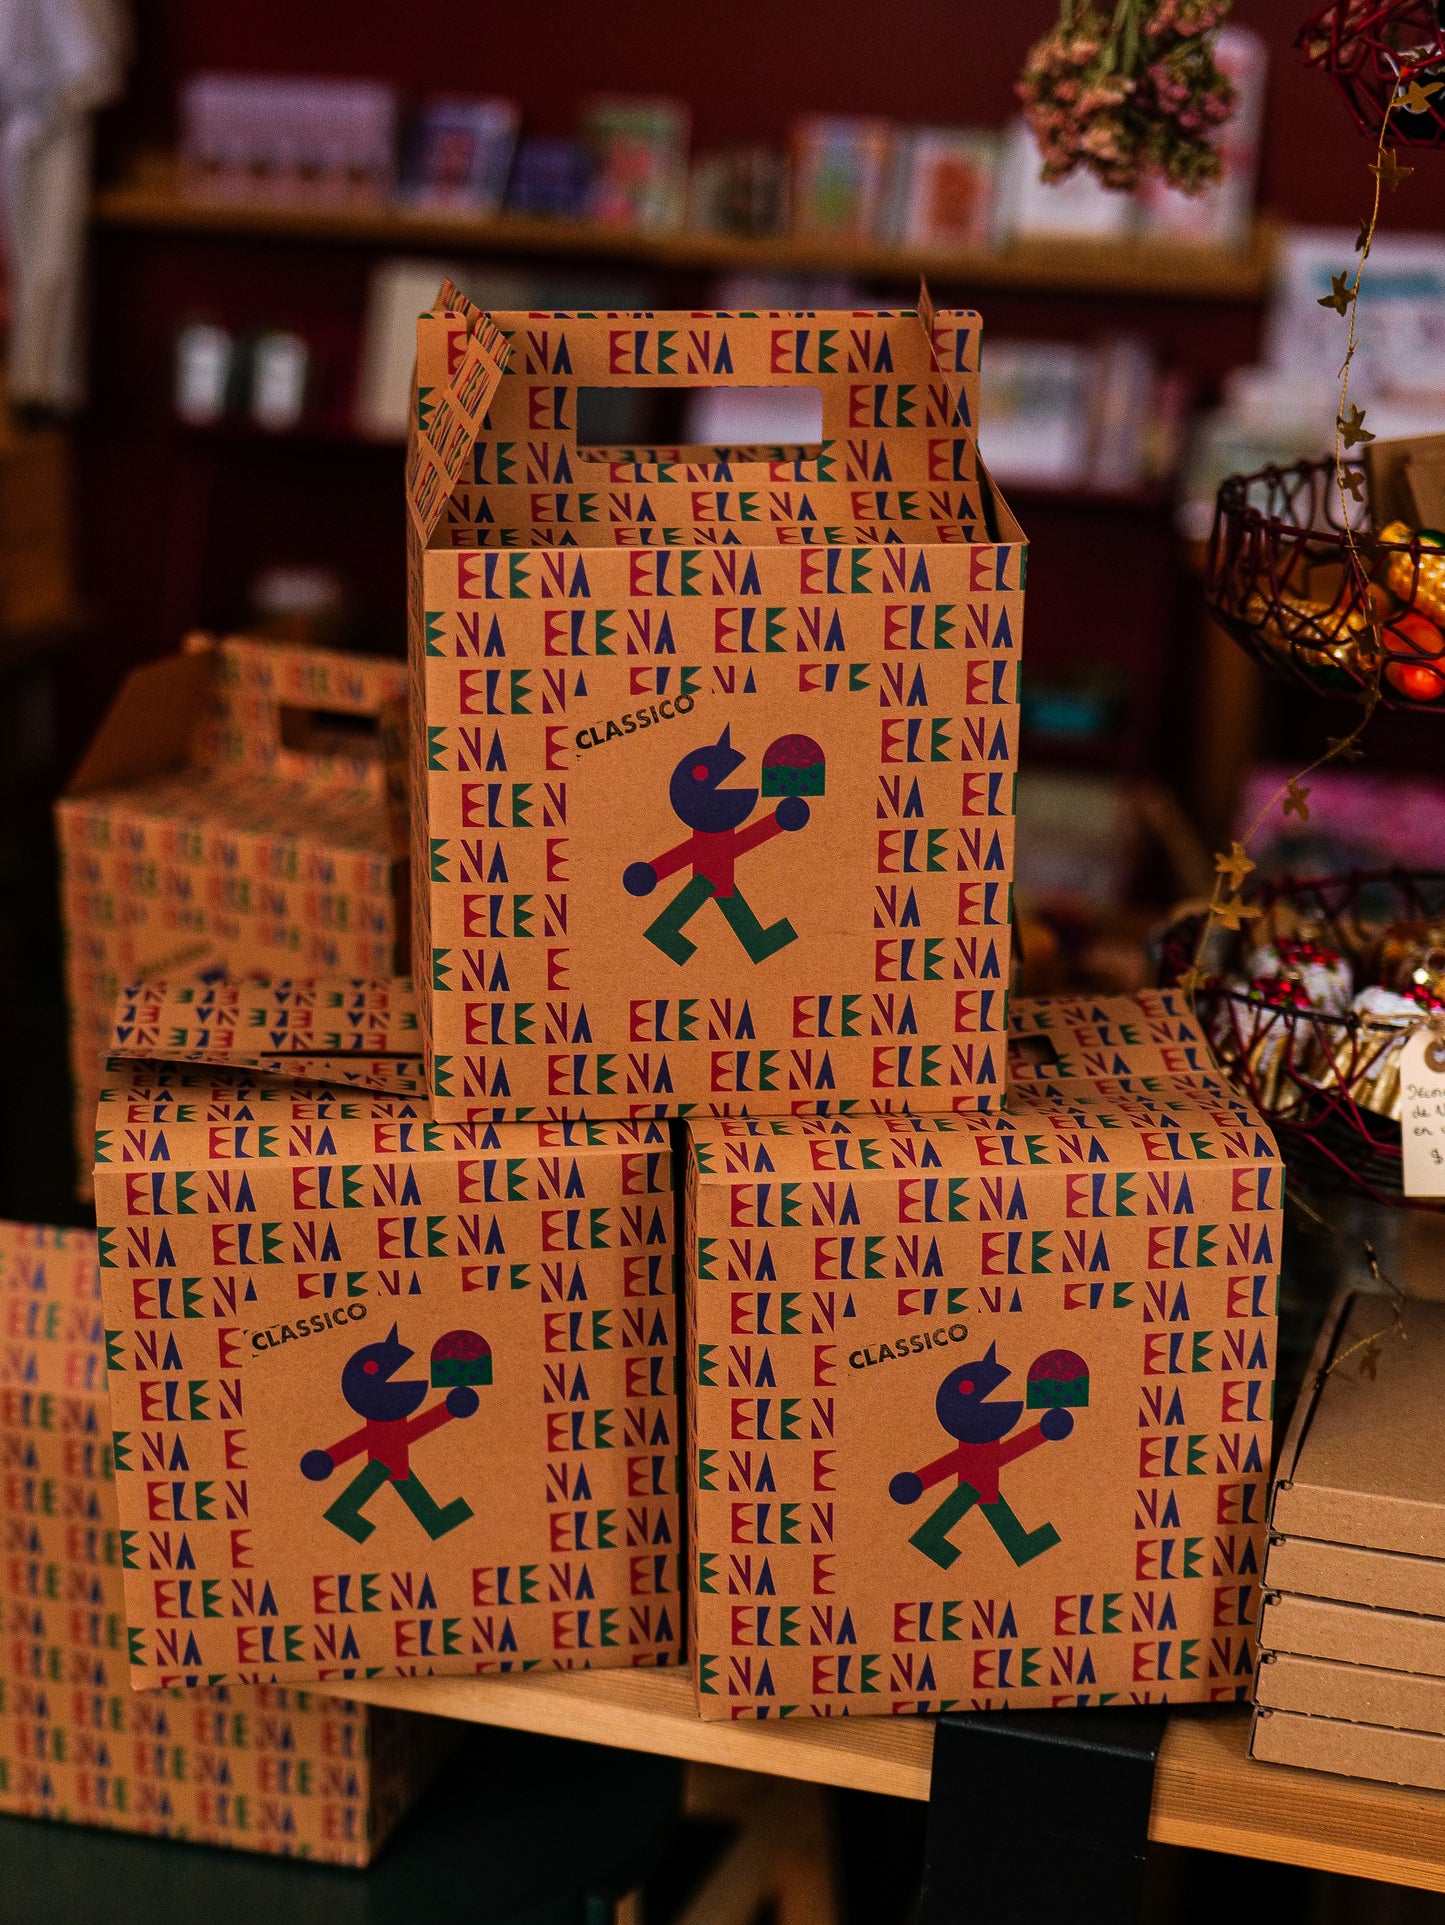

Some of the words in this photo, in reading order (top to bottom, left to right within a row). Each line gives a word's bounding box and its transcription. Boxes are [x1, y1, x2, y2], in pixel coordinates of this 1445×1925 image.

[609, 330, 734, 375] ELENA
[770, 329, 894, 374] ELENA
[930, 329, 982, 373] EL
[528, 386, 571, 430] EL
[848, 383, 972, 428] ELENA
[530, 493, 656, 523] ELENA
[691, 491, 817, 522] ELENA
[850, 491, 978, 520] ELENA
[451, 528, 578, 545] ELENA
[615, 527, 743, 545] ELENA
[777, 527, 904, 544] ELENA
[458, 552, 591, 599] ELENA
[630, 550, 761, 597] ELENA
[800, 548, 931, 594] ELENA
[425, 612, 505, 657] ENA
[544, 609, 676, 656] ELENA
[715, 607, 845, 653] ELENA
[884, 604, 1013, 650] ELENA
[967, 660, 1021, 704] EL
[428, 727, 507, 772] ENA
[881, 717, 1009, 763] ELENA
[575, 693, 694, 751] CLASSICO
[461, 783, 566, 828] ELEN
[877, 775, 924, 819] NA
[963, 772, 1017, 816] EL
[430, 839, 508, 883] ENA
[878, 828, 1005, 873] ELENA
[463, 894, 567, 938] ELEN
[874, 885, 921, 928] NA
[958, 881, 1013, 925] EL
[433, 948, 510, 992] ENA
[875, 937, 1000, 982] ELENA
[465, 1002, 592, 1045] ELENA
[629, 998, 756, 1042] ELENA
[793, 993, 918, 1038] ELENA
[955, 990, 1008, 1032] EL
[1074, 1022, 1196, 1048] ELENA
[435, 1055, 511, 1097] ENA
[548, 1053, 674, 1096] ELENA
[711, 1049, 836, 1092] ELENA
[872, 1044, 996, 1088] ELENA
[1094, 1076, 1222, 1094] ELENA
[127, 1104, 254, 1123] ELENA
[292, 1104, 417, 1120] ELENA
[720, 1121, 851, 1136] ELENA
[884, 1118, 1016, 1132] ELENA
[1048, 1114, 1181, 1129] ELENA
[97, 1128, 171, 1163] ENA
[209, 1125, 337, 1159] ELENA
[374, 1121, 502, 1153] ELENA
[696, 1143, 776, 1174] ENA
[809, 1138, 942, 1171] ELENA
[975, 1134, 1109, 1166] ELENA
[1140, 1132, 1274, 1161] ELENA
[126, 1170, 256, 1216] ELENA
[292, 1164, 421, 1210] ELENA
[458, 1157, 585, 1203] ELENA
[731, 1182, 860, 1227] ELENA
[898, 1177, 1028, 1223] ELENA
[1066, 1171, 1194, 1218] ELENA
[1231, 1167, 1285, 1211] EL
[99, 1225, 177, 1268] ENA
[212, 1221, 341, 1266] ELENA
[377, 1214, 505, 1259] ELENA
[541, 1205, 667, 1252] ELENA
[698, 1238, 776, 1281] ENA
[815, 1235, 943, 1280] ELENA
[981, 1230, 1110, 1275] ELENA
[1148, 1223, 1273, 1269] ELENA
[623, 1255, 676, 1296] EL
[1226, 1275, 1281, 1318] EL
[104, 1330, 183, 1371] ENA
[544, 1307, 668, 1353] ELENA
[251, 1302, 367, 1351] CLASSICO
[848, 1323, 969, 1370] CLASSICO
[699, 1344, 776, 1387] ENA
[1143, 1329, 1267, 1375] ELENA
[139, 1379, 242, 1422] ELEN
[543, 1363, 590, 1403] NA
[625, 1356, 678, 1397] EL
[731, 1398, 834, 1440] ELEN
[1139, 1386, 1185, 1427] NA
[1222, 1380, 1273, 1422] EL
[112, 1431, 190, 1472] ENA
[547, 1407, 670, 1453] ELENA
[699, 1449, 776, 1492] ENA
[1139, 1433, 1263, 1478] ELENA
[147, 1480, 248, 1521] ELEN
[546, 1462, 592, 1503] NA
[627, 1454, 680, 1497] EL
[731, 1502, 833, 1544] ELEN
[1134, 1488, 1181, 1530] NA
[1218, 1482, 1272, 1524] EL
[119, 1530, 196, 1570] ENA
[549, 1506, 672, 1553] ELENA
[700, 1553, 776, 1596] ENA
[1136, 1535, 1258, 1581] ELENA
[154, 1578, 278, 1619] ELENA
[312, 1572, 437, 1614] ELENA
[472, 1562, 595, 1607] ELENA
[629, 1554, 680, 1595] EL
[127, 1627, 202, 1666] ENA
[236, 1623, 360, 1664] ELENA
[394, 1616, 518, 1658] ELENA
[552, 1605, 674, 1650] ELENA
[731, 1605, 857, 1646] ELENA
[893, 1599, 1018, 1643] ELENA
[1054, 1591, 1177, 1636] ELENA
[699, 1654, 775, 1696] ENA
[812, 1653, 937, 1694] ELENA
[973, 1646, 1096, 1689] ELENA
[1133, 1637, 1254, 1682] ELENA
